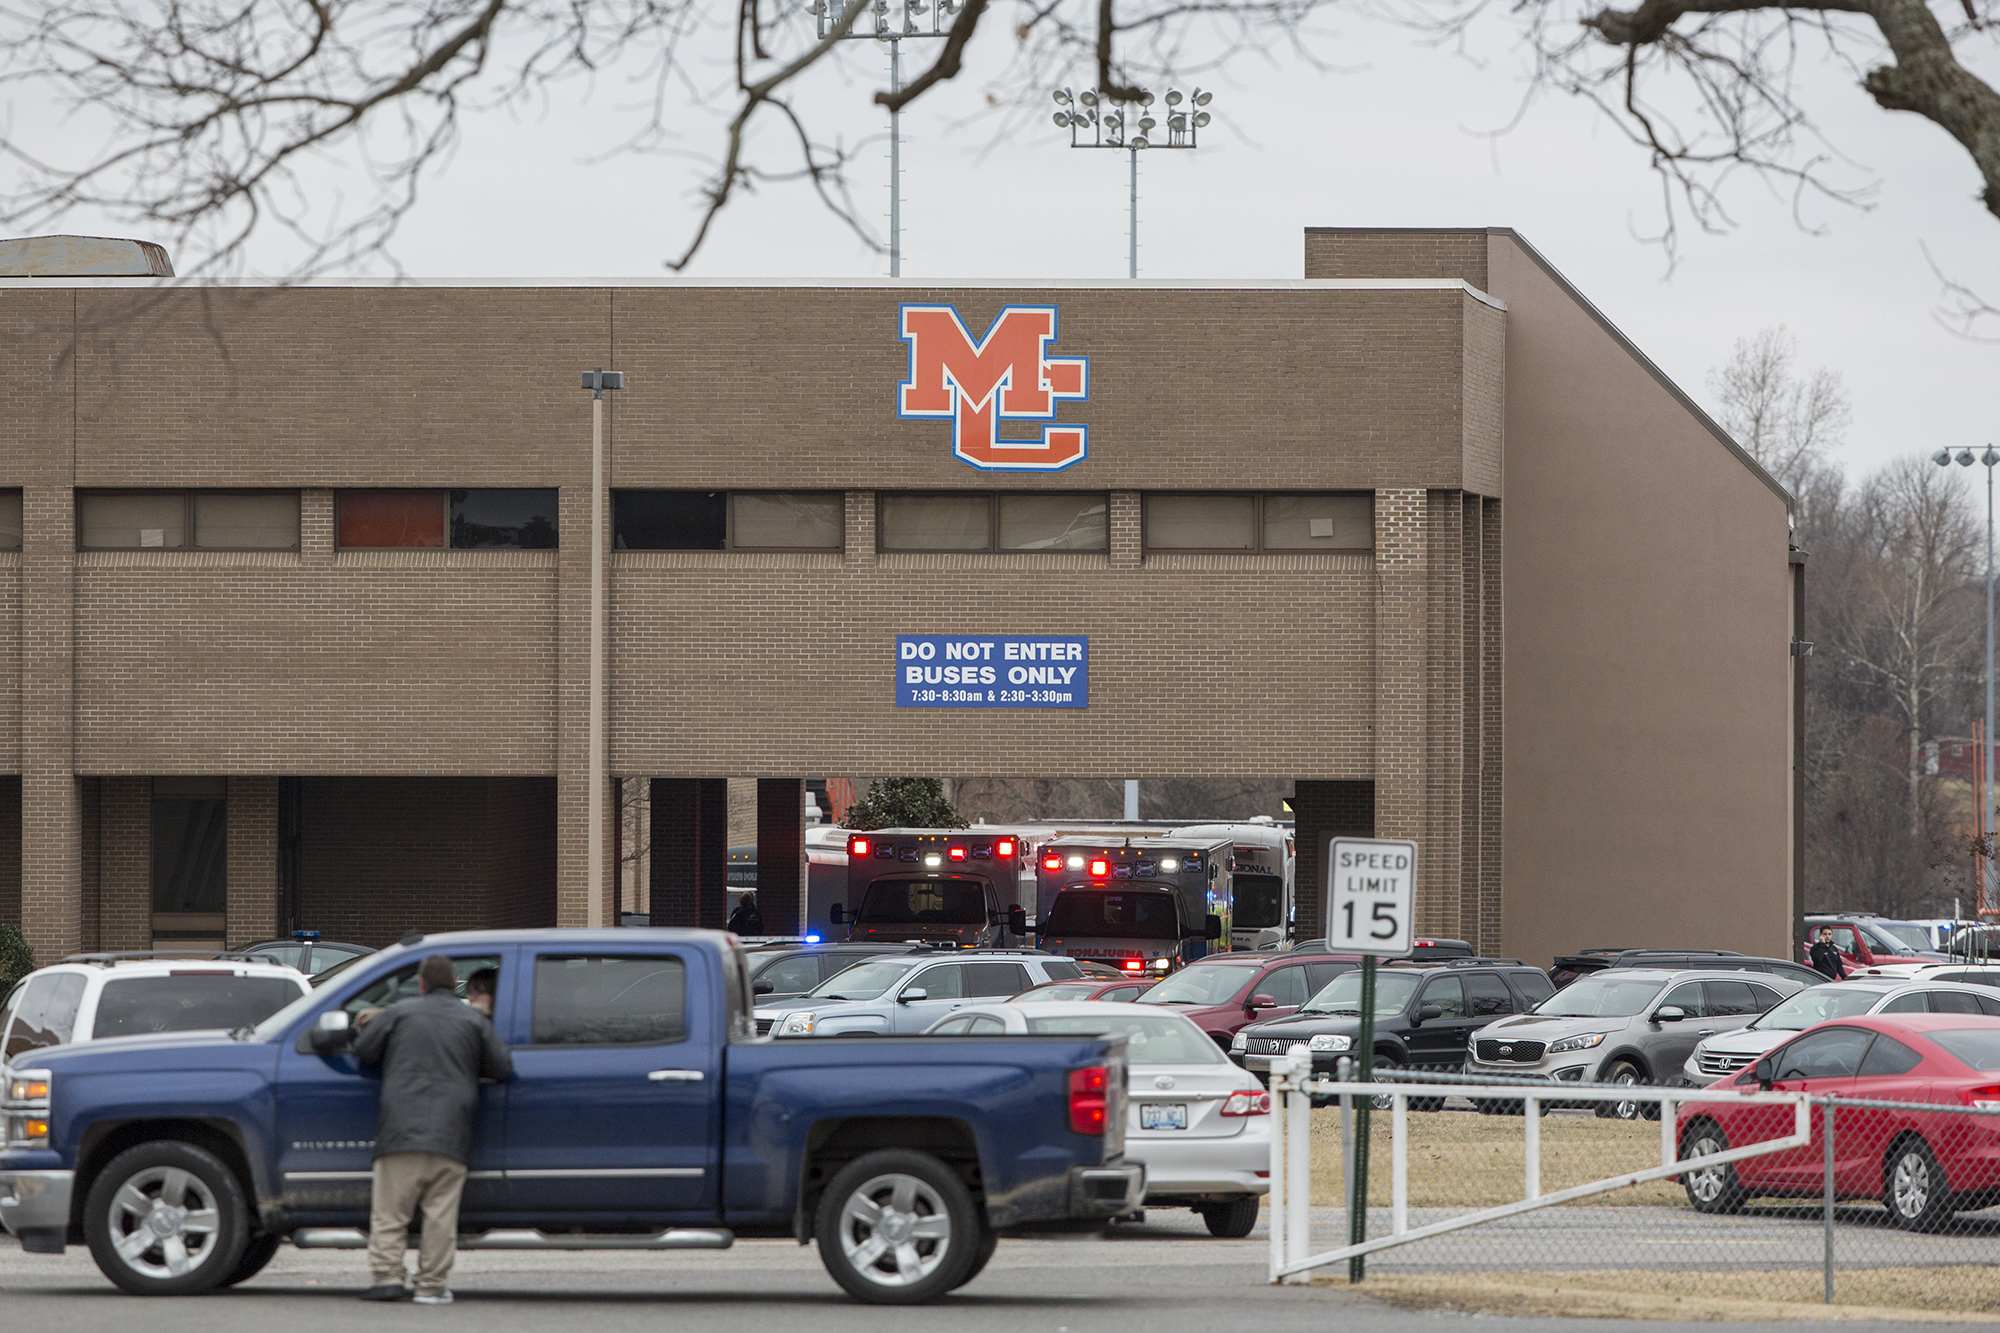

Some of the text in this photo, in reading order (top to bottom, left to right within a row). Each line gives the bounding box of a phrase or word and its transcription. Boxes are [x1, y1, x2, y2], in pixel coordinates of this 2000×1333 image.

[897, 303, 1090, 472] MC
[901, 642, 1082, 660] DO NOT ENTER
[906, 666, 1077, 684] BUSES ONLY
[911, 690, 1072, 703] 7:30-8:30am & 2:30-3:30pm
[1233, 863, 1273, 874] GIONAL
[1340, 852, 1408, 870] SPEED
[727, 872, 757, 881] STATE POLI
[1347, 876, 1399, 893] LIMIT
[1342, 901, 1398, 940] 15
